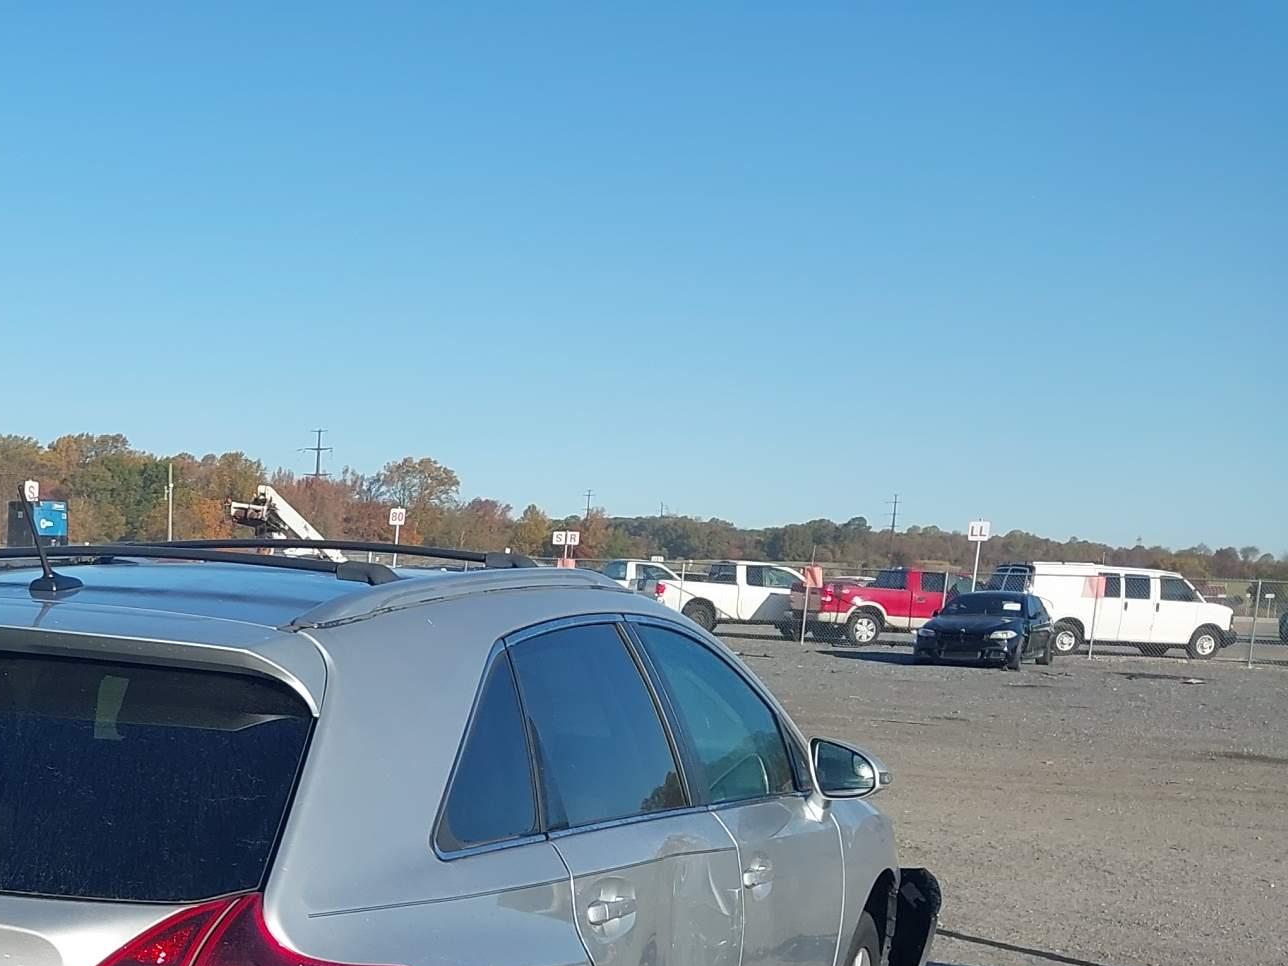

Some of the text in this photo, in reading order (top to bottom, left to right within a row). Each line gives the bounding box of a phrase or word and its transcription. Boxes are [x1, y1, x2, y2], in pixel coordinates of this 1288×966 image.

[391, 511, 404, 522] 80
[970, 525, 987, 537] LL
[555, 533, 563, 543] S
